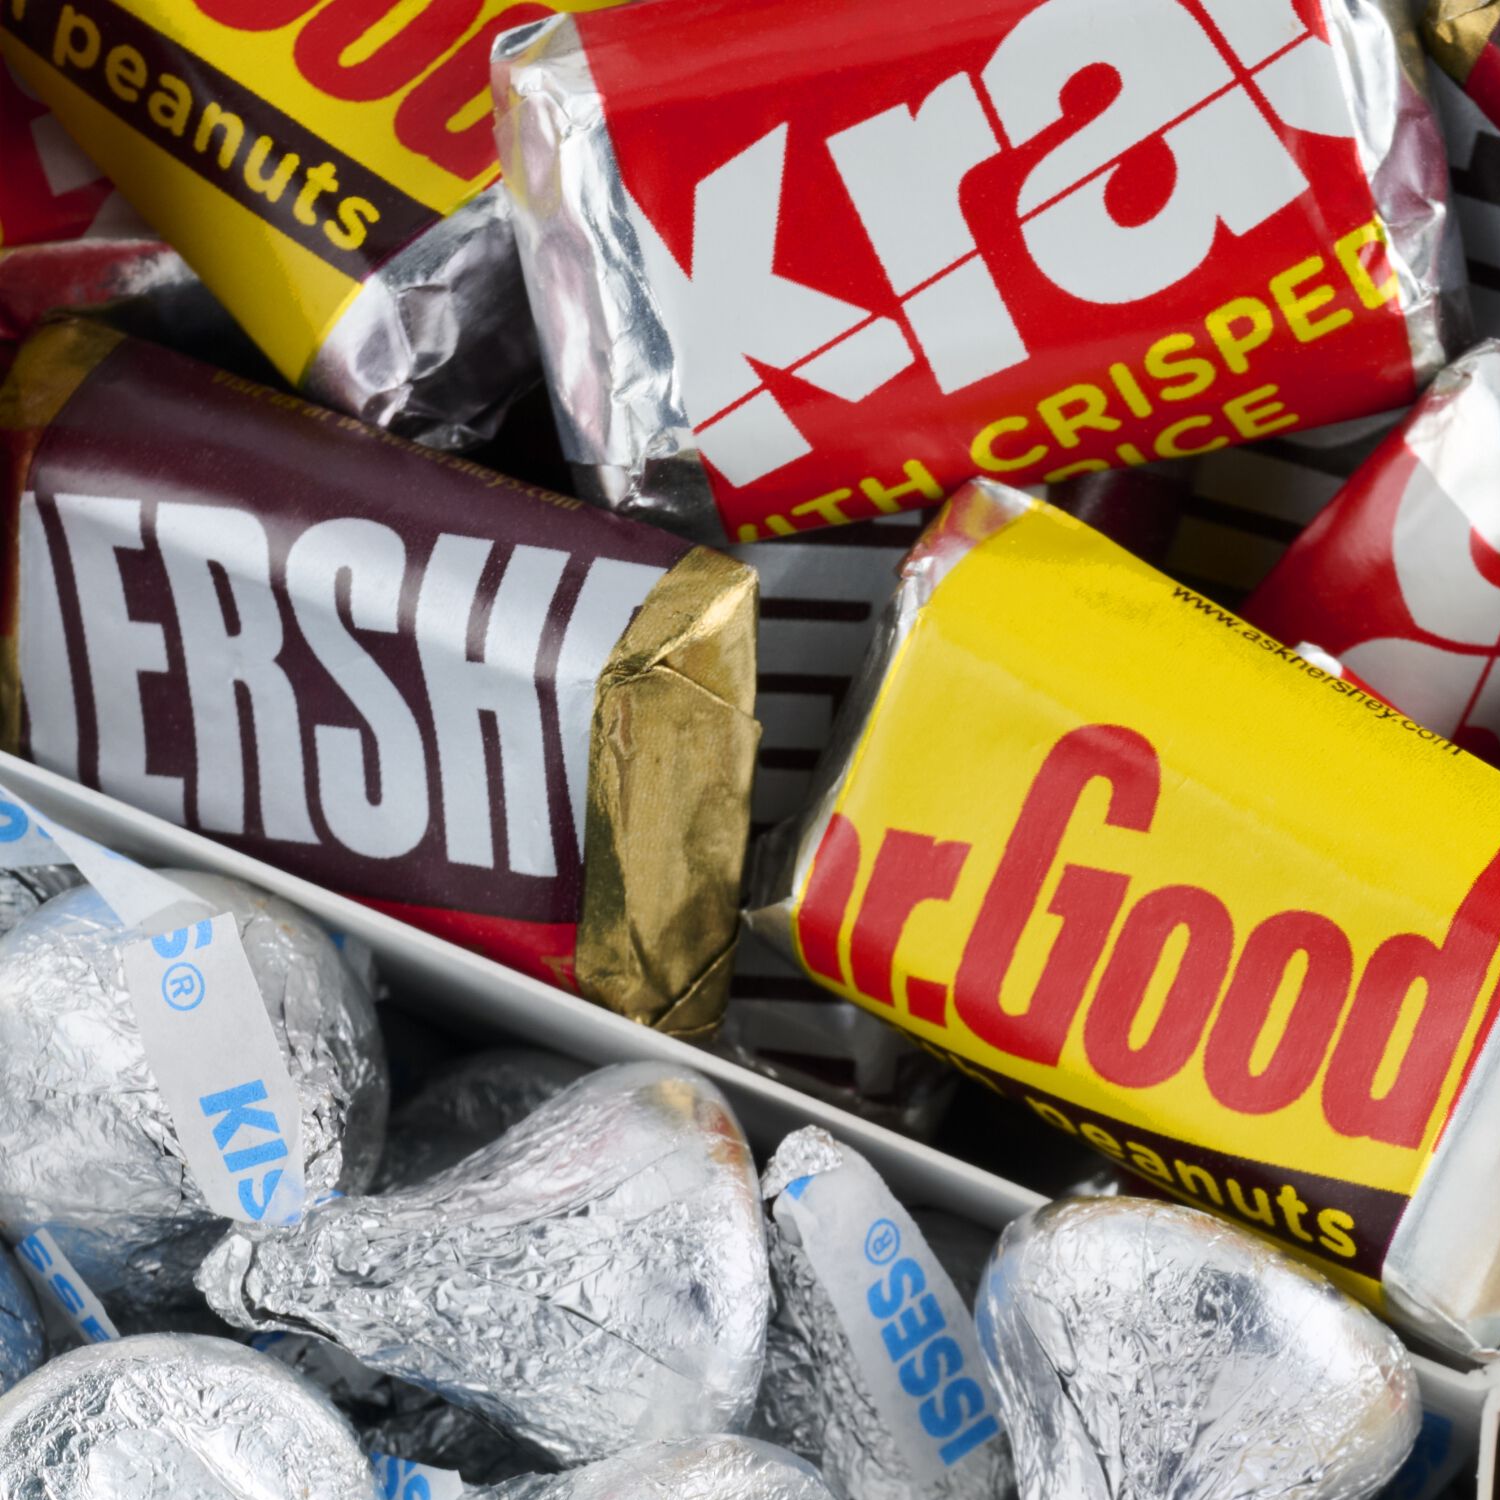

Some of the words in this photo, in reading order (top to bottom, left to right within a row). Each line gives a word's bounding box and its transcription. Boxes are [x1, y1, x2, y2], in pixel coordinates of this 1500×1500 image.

[53, 4, 381, 251] peanuts
[738, 459, 945, 543] TH
[969, 215, 1404, 472] CRISPED
[1024, 1094, 1358, 1260] peanuts
